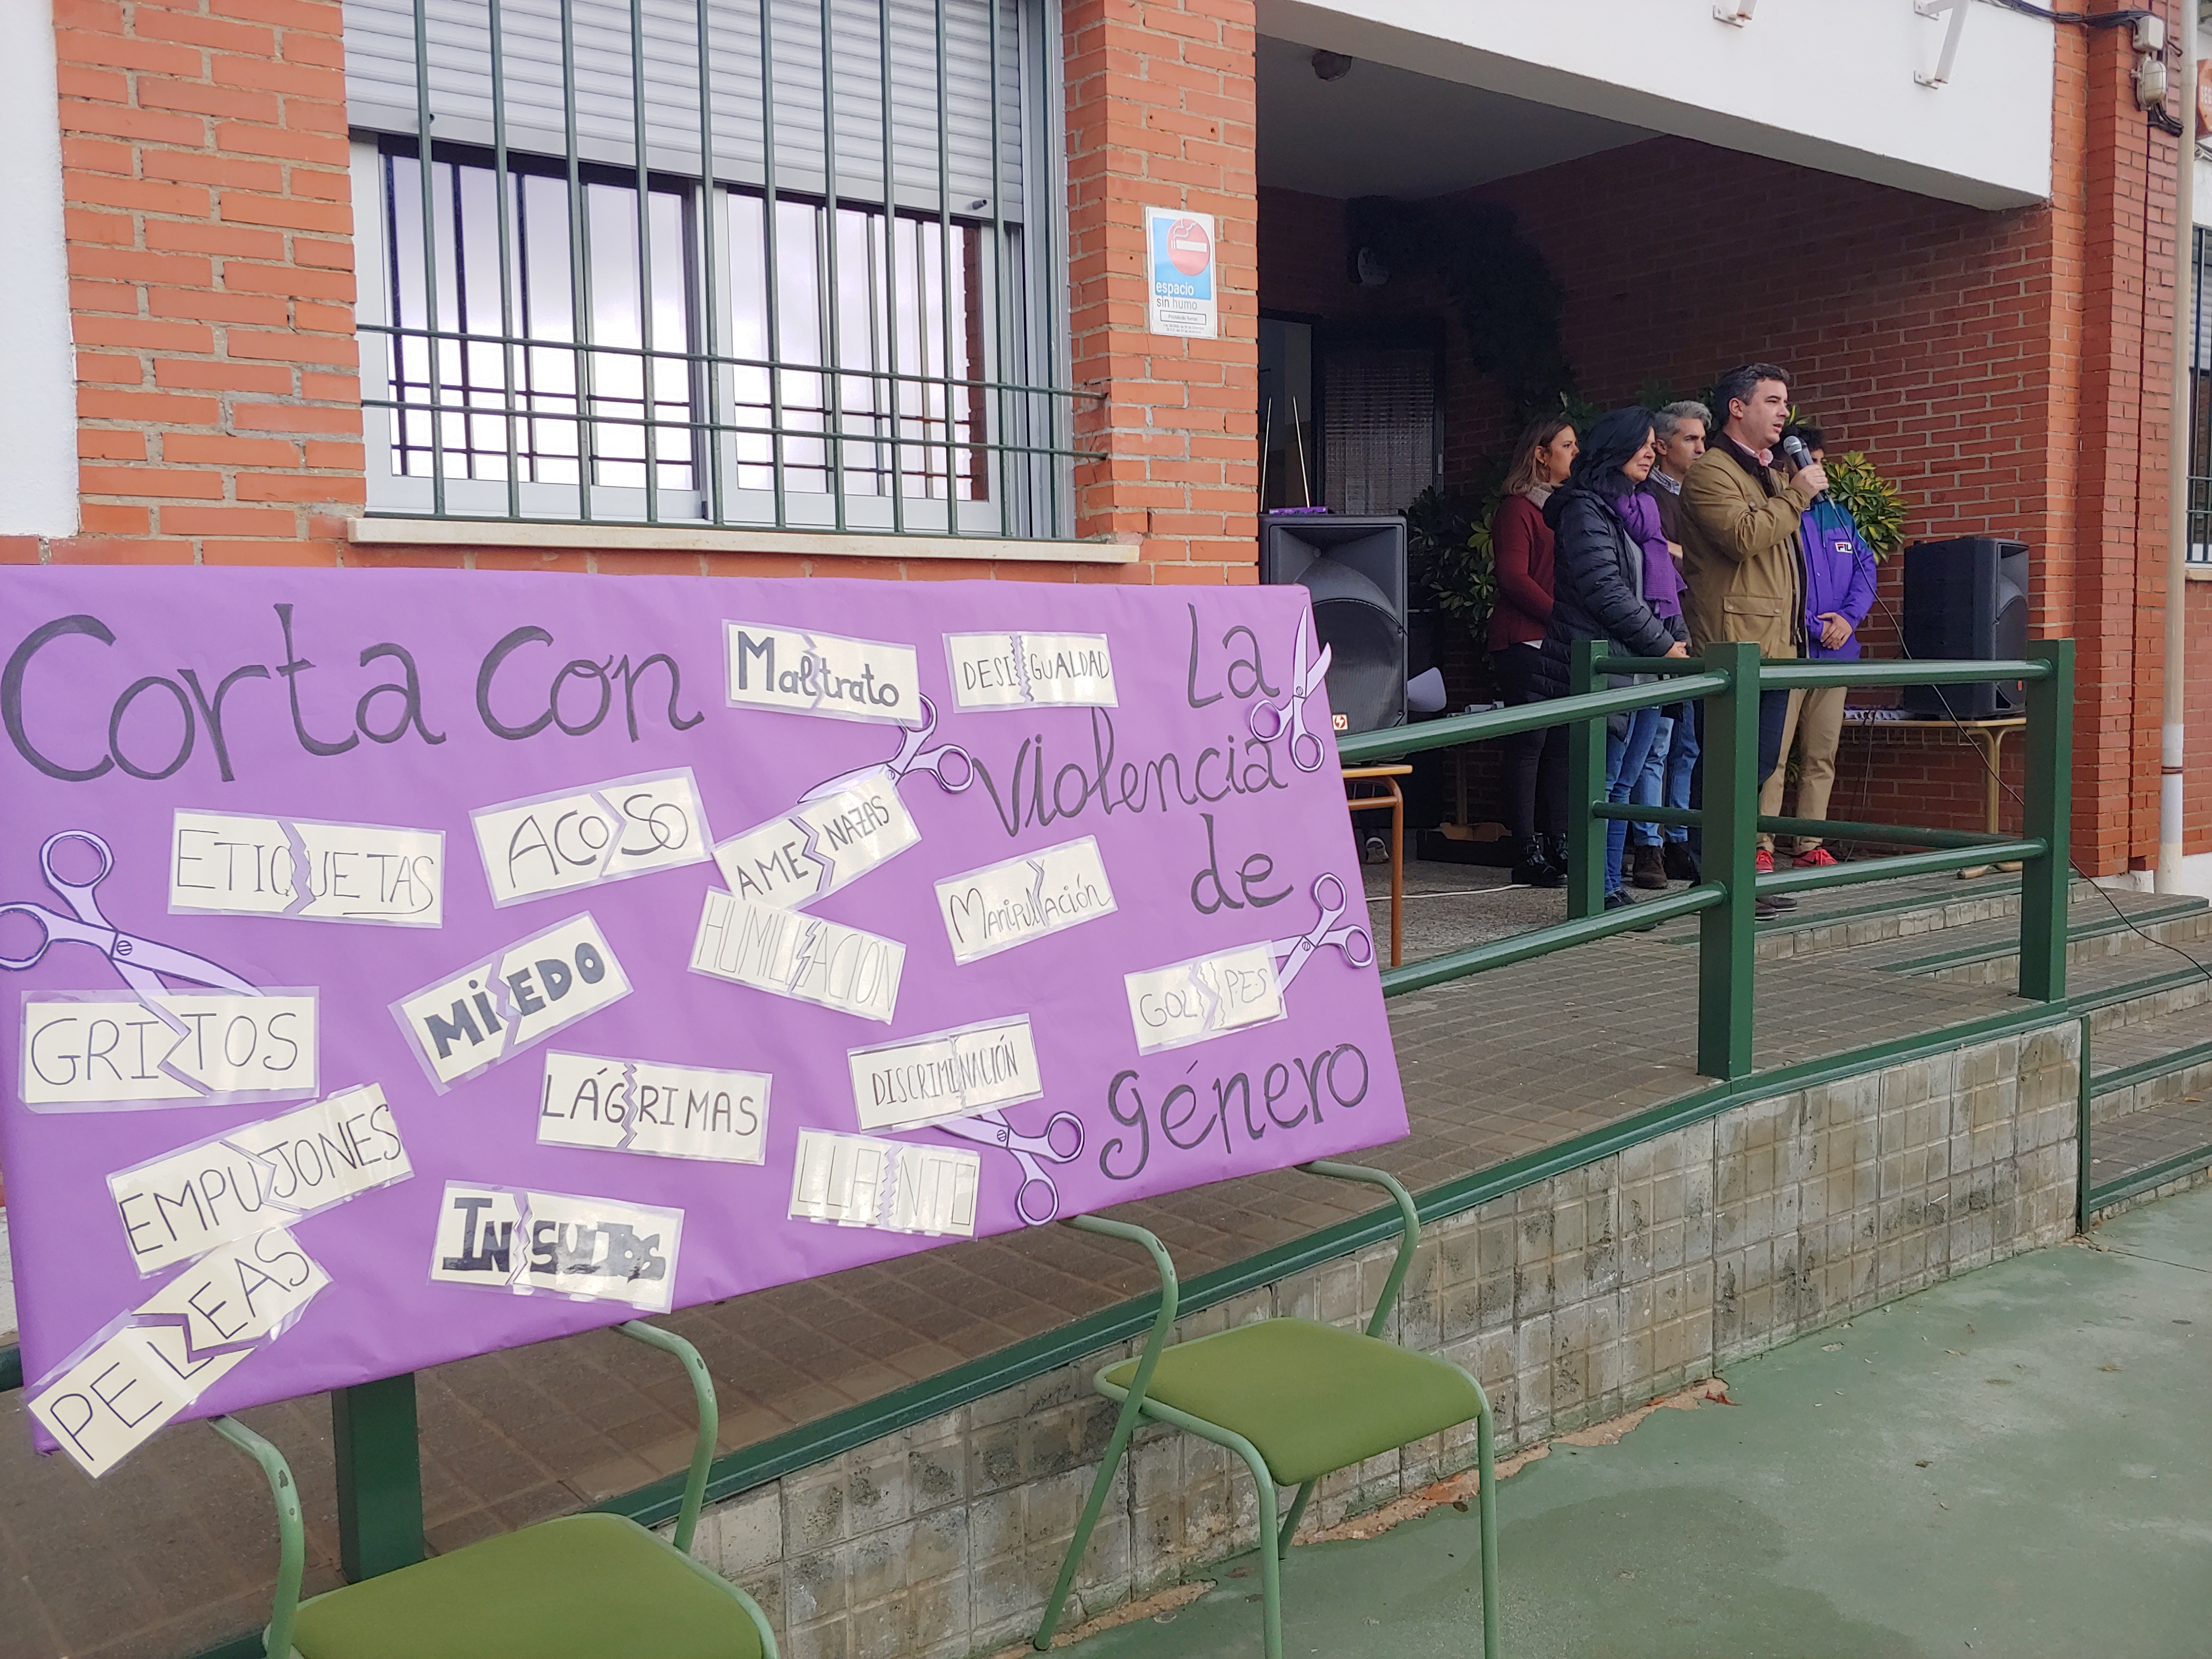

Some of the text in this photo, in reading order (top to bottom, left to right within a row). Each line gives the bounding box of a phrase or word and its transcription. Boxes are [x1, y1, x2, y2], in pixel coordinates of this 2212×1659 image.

[1156, 282, 1194, 297] espacio
[1156, 296, 1197, 310] sin humo
[1, 603, 447, 782] Corta
[738, 630, 899, 707] Maltrato
[963, 650, 1109, 690] DESIGUALDAD
[1188, 602, 1281, 708] La
[175, 829, 434, 915] ETIQUETAS
[508, 793, 688, 889] ACOSO
[736, 795, 890, 901] AMENAZAS
[1191, 813, 1294, 915] de
[1140, 968, 1268, 1027] GOLPES
[31, 1012, 298, 1086] GRITOS
[872, 1034, 1019, 1106] DISCRIMINACIÓN
[542, 1067, 758, 1136] LÁGRIMAS
[1099, 1043, 1369, 1180] género
[117, 1103, 401, 1255] EMPUJONES
[798, 1138, 976, 1226] LLANTO
[50, 1227, 310, 1461] PELEAS
